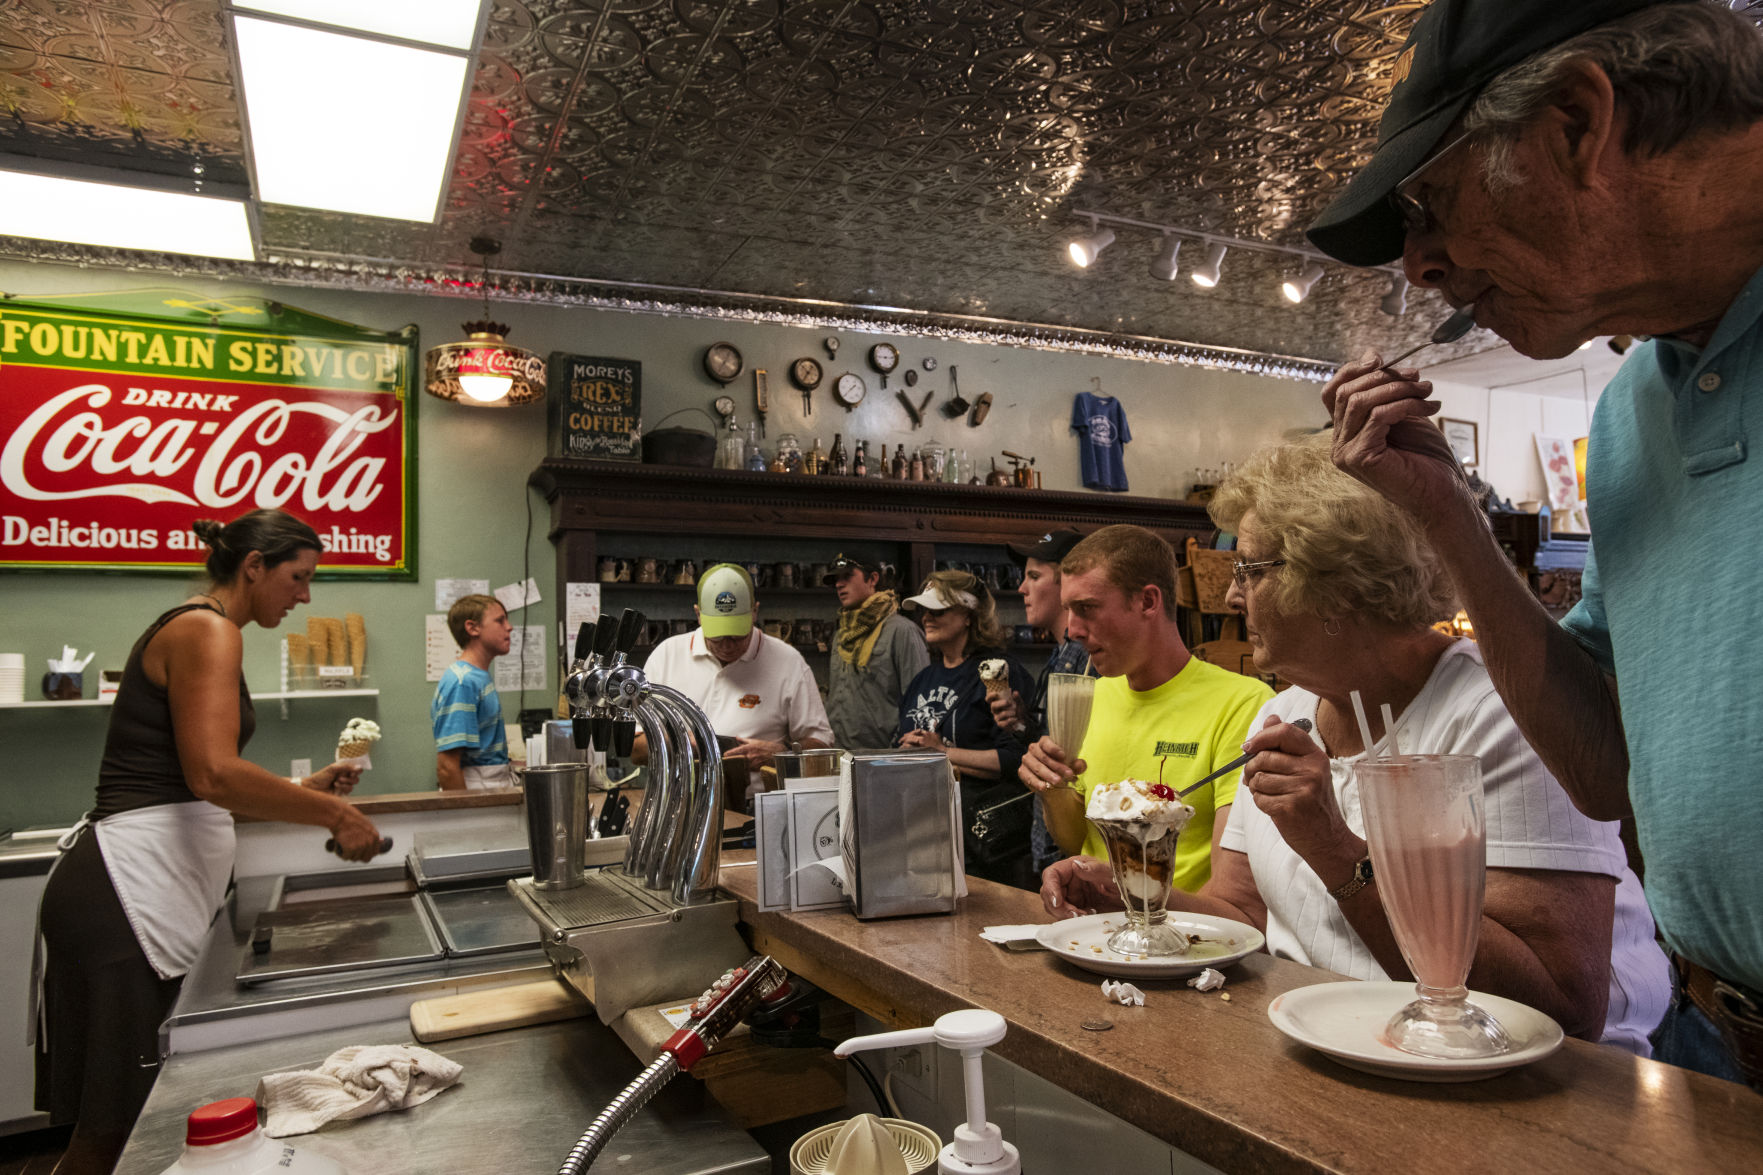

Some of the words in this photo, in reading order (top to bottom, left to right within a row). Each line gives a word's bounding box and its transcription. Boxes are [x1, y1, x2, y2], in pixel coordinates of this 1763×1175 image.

[1, 319, 217, 370] FOUNTAIN
[227, 339, 397, 384] SERVICE
[436, 350, 485, 371] Drink
[573, 364, 633, 383] MOREY'S
[121, 387, 239, 412] DRINK
[581, 381, 622, 404] REX
[569, 412, 634, 433] COFFEE
[0, 384, 398, 512] Coca-Cola
[2, 515, 159, 549] Delicious
[166, 527, 213, 550] an
[917, 686, 959, 710] ALTU
